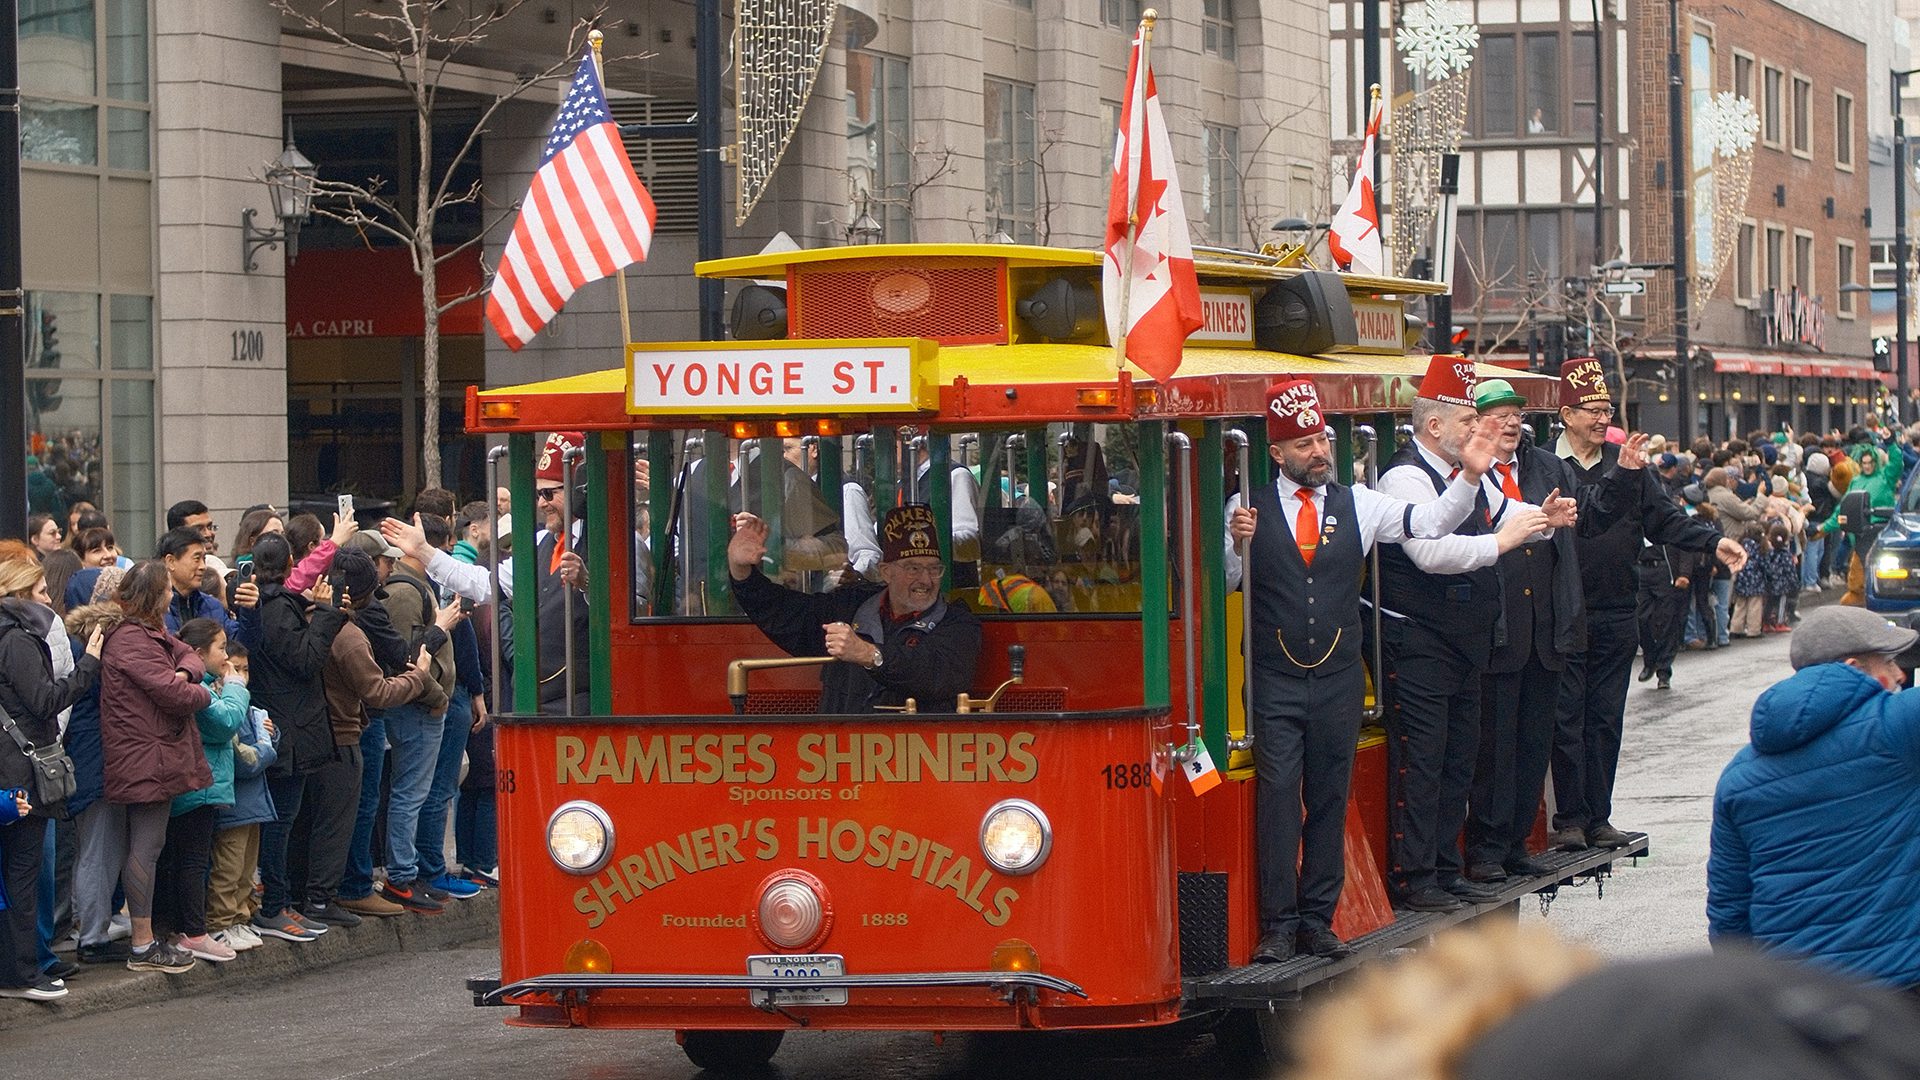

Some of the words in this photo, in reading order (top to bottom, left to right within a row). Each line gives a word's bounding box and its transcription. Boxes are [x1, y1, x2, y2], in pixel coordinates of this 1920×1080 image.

[312, 319, 374, 336] CAPRI
[231, 330, 263, 361] 1200
[652, 362, 804, 396] YONGE
[832, 361, 898, 394] ST.
[556, 734, 777, 784] RAMESES
[796, 732, 1039, 784] SHRINERS
[1101, 763, 1152, 790] 1888
[729, 786, 832, 805] Sponsors
[838, 784, 862, 801] of
[573, 817, 780, 929] SHRINER'S
[797, 816, 1020, 927] HOSPITALS
[662, 914, 747, 928] Founded
[861, 913, 909, 926] 1888
